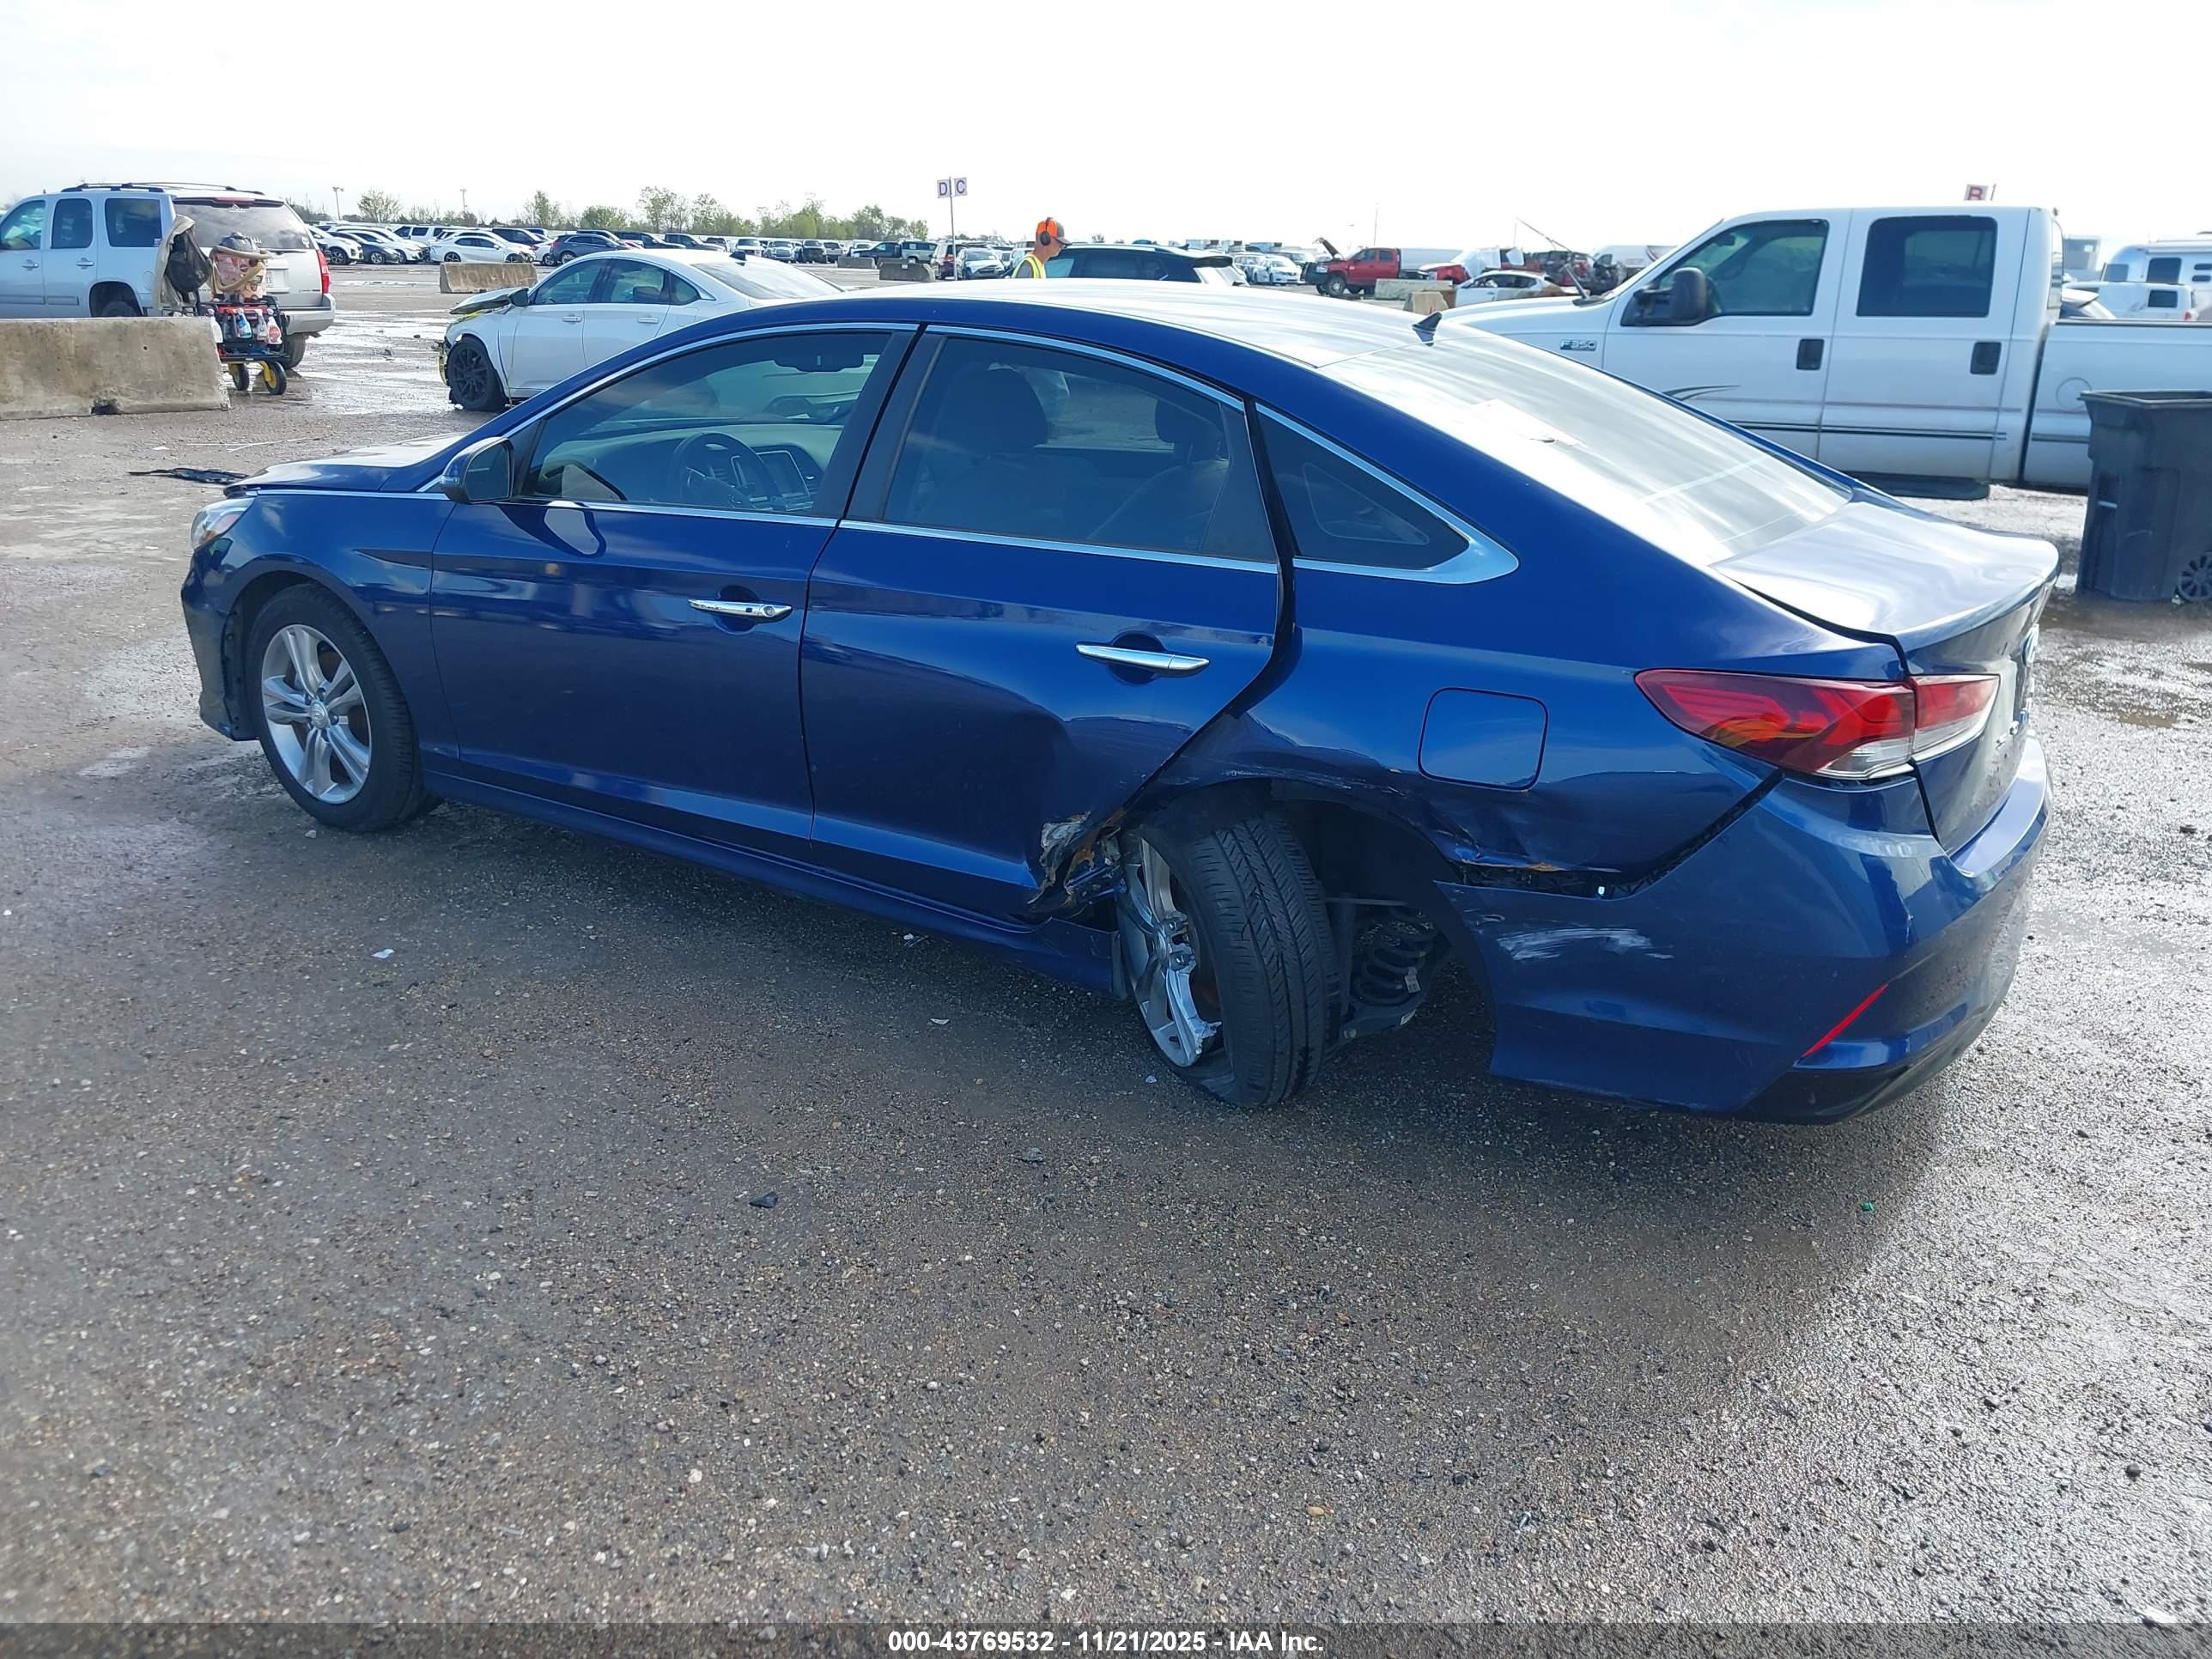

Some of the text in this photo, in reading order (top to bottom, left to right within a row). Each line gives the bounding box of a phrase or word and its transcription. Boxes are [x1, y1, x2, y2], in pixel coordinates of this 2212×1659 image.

[939, 181, 948, 196] D
[956, 179, 965, 194] C
[1967, 185, 1983, 200] R
